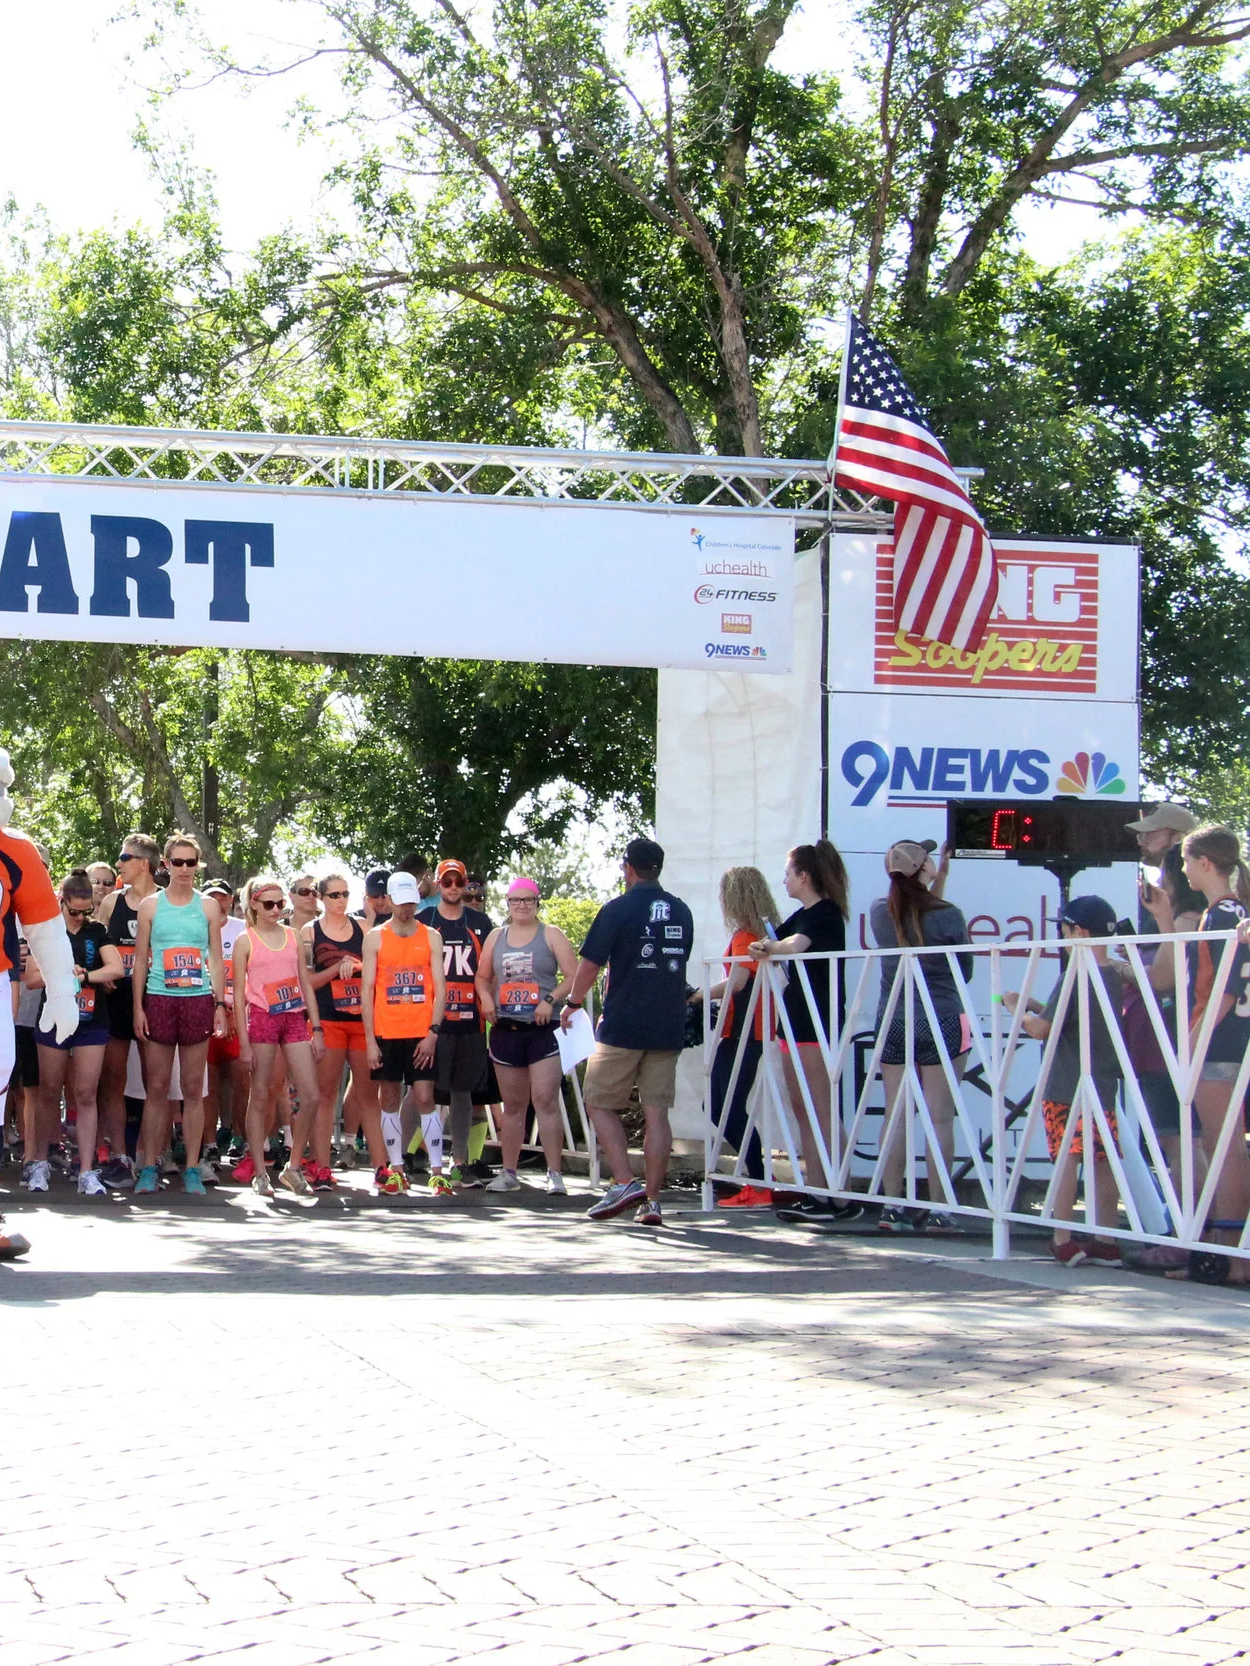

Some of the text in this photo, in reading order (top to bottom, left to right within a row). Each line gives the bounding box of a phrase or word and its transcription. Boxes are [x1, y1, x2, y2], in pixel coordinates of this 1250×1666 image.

[705, 559, 768, 577] uchealth
[715, 589, 779, 602] FITNESS
[841, 740, 1051, 807] 9NEWS
[173, 953, 195, 968] 154
[394, 972, 417, 985] 367
[506, 990, 530, 1003] 282
